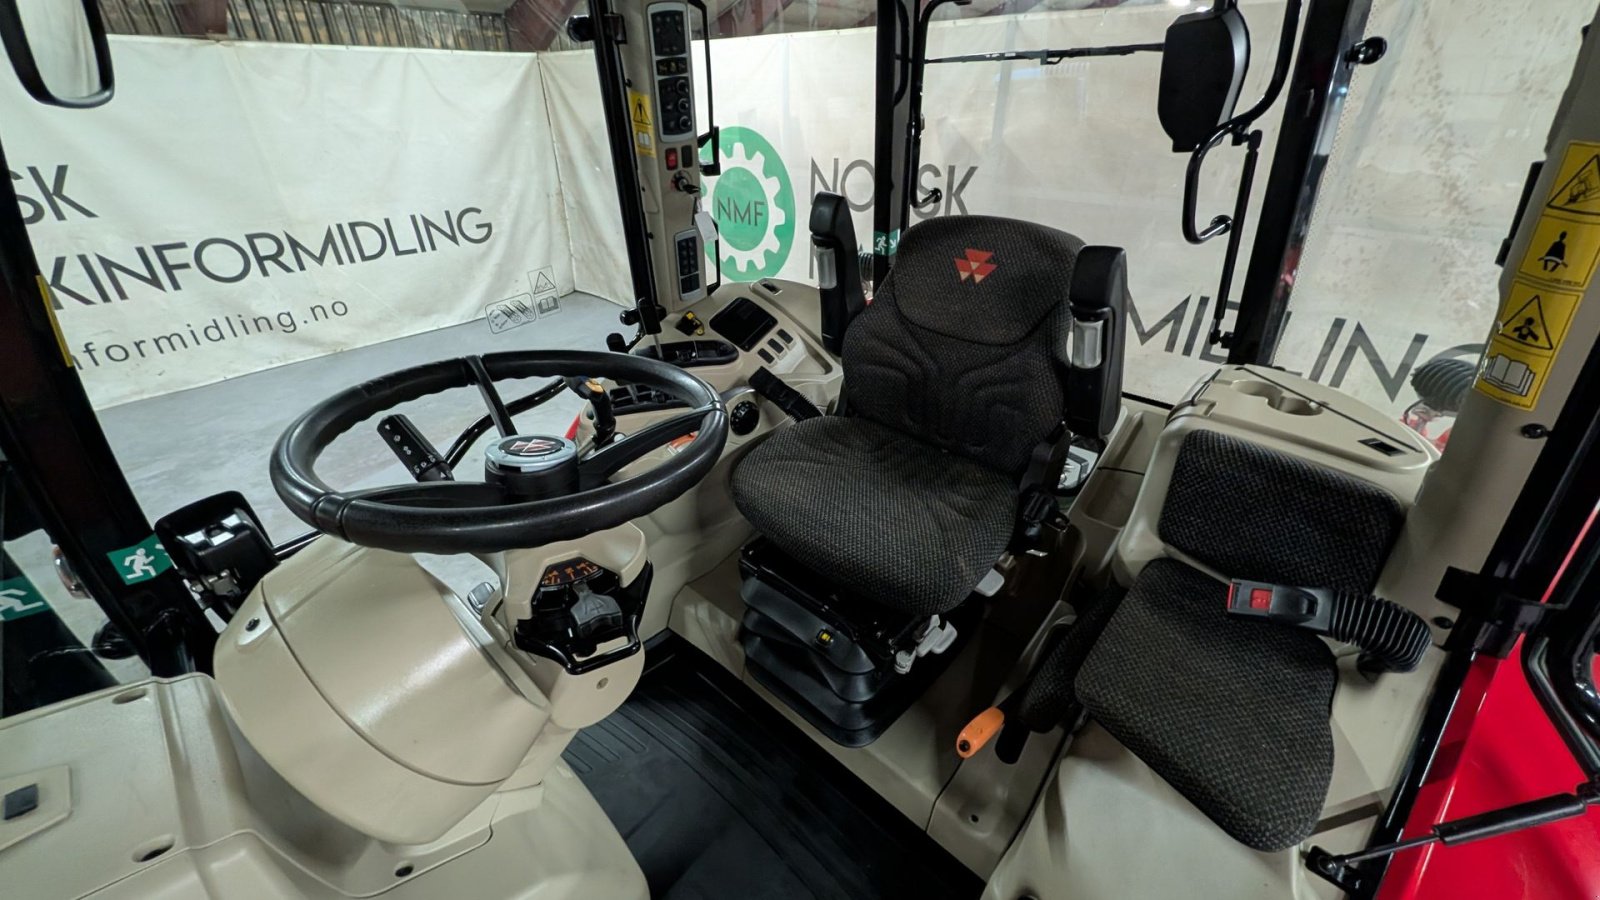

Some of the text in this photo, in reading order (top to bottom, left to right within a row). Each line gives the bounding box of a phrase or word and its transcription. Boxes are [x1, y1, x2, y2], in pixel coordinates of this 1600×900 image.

[717, 197, 765, 226] NMF
[810, 157, 978, 219] NOSK
[49, 207, 493, 310] KINFORMIDLING
